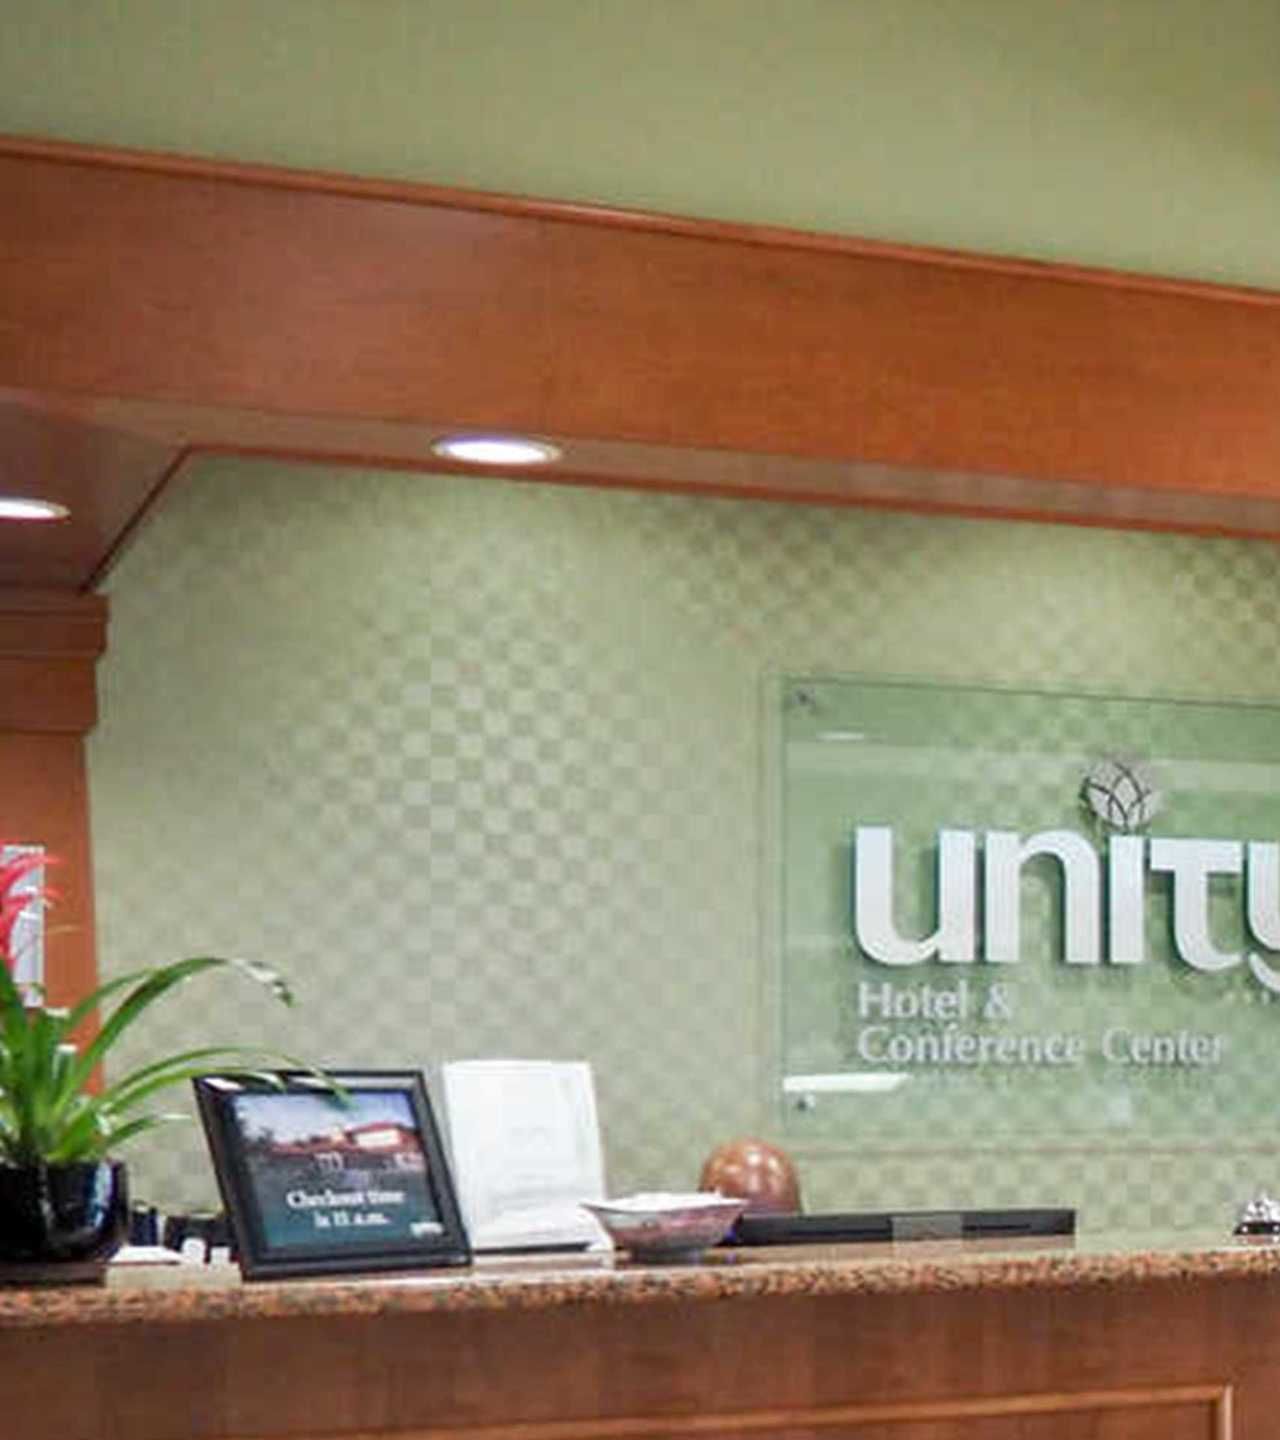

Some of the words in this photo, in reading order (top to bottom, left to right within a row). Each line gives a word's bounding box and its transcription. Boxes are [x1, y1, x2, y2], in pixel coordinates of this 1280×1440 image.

[858, 980, 969, 1020] Hotel
[983, 982, 1013, 1020] &
[858, 1022, 1085, 1064] Conference
[1101, 1026, 1223, 1064] Center
